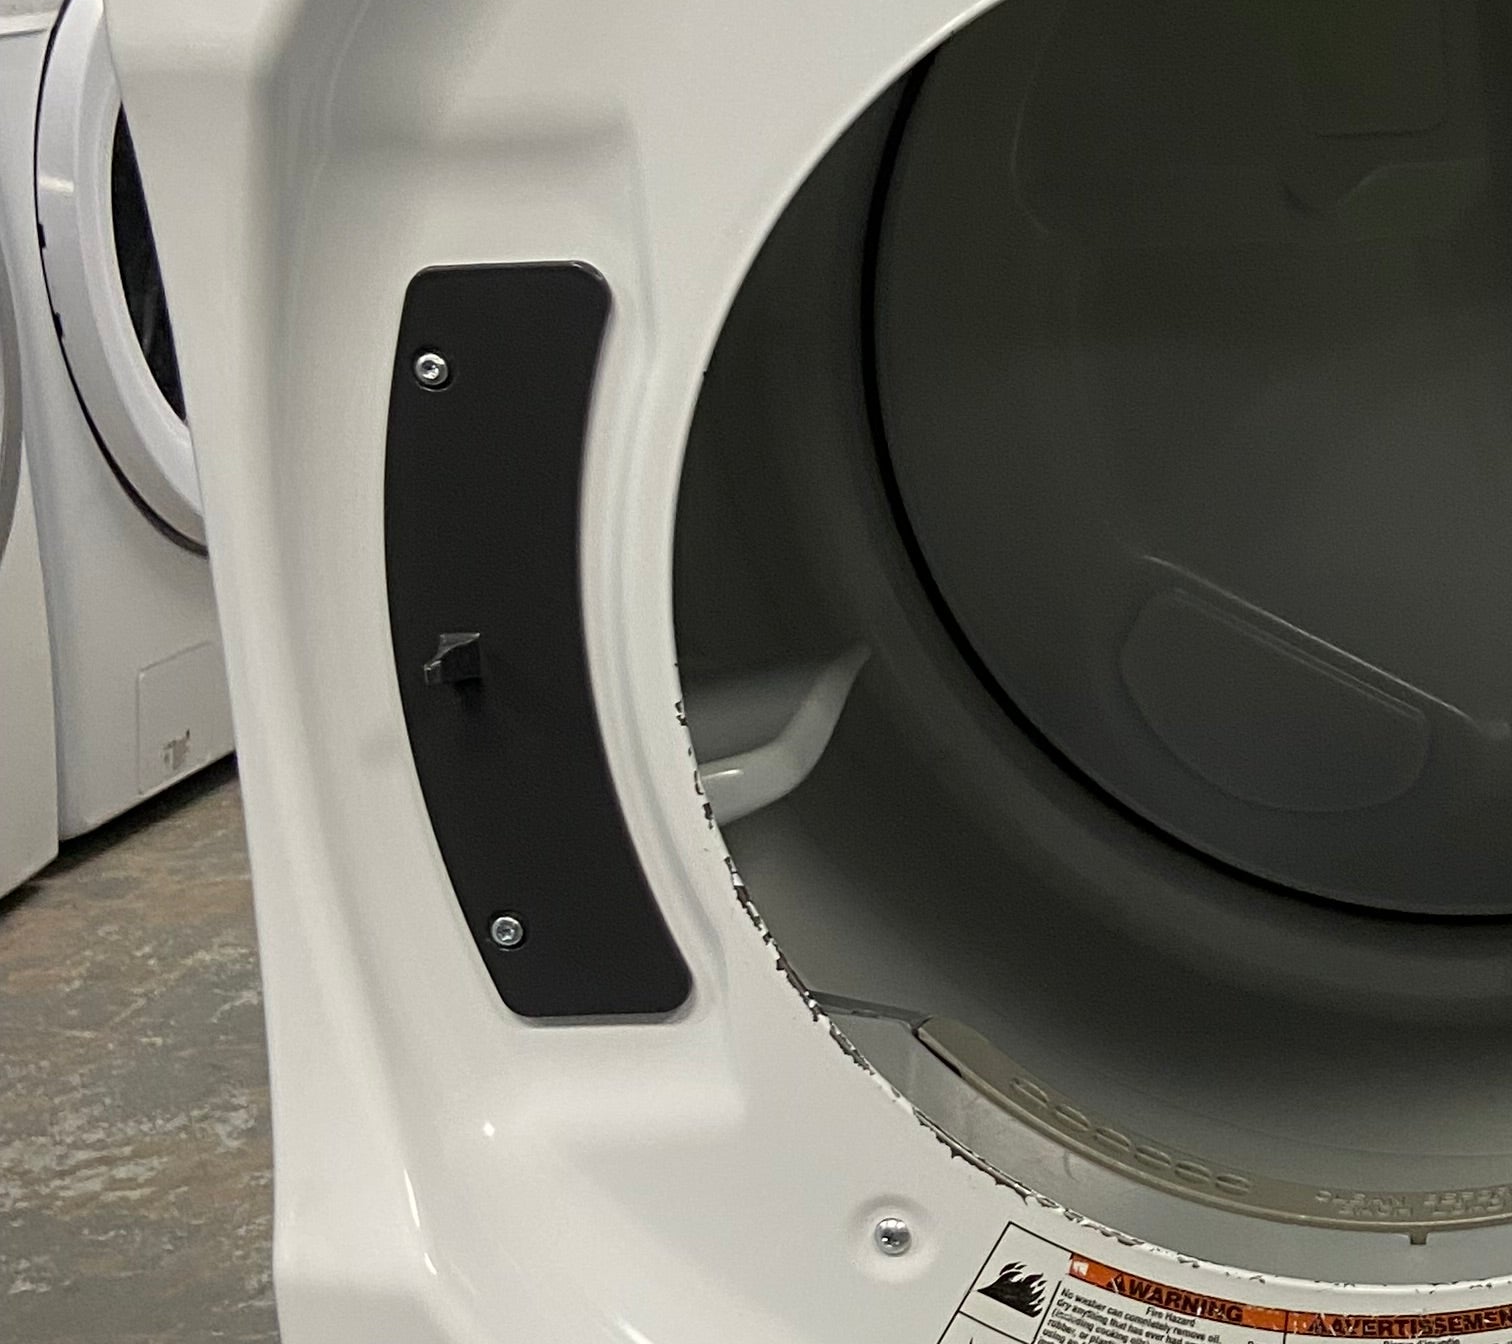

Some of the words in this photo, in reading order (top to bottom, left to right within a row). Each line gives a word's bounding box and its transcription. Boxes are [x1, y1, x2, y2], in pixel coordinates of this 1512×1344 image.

[1128, 1278, 1243, 1322] WARNING
[1146, 1306, 1164, 1319] Fire
[1166, 1312, 1195, 1327] Hazard
